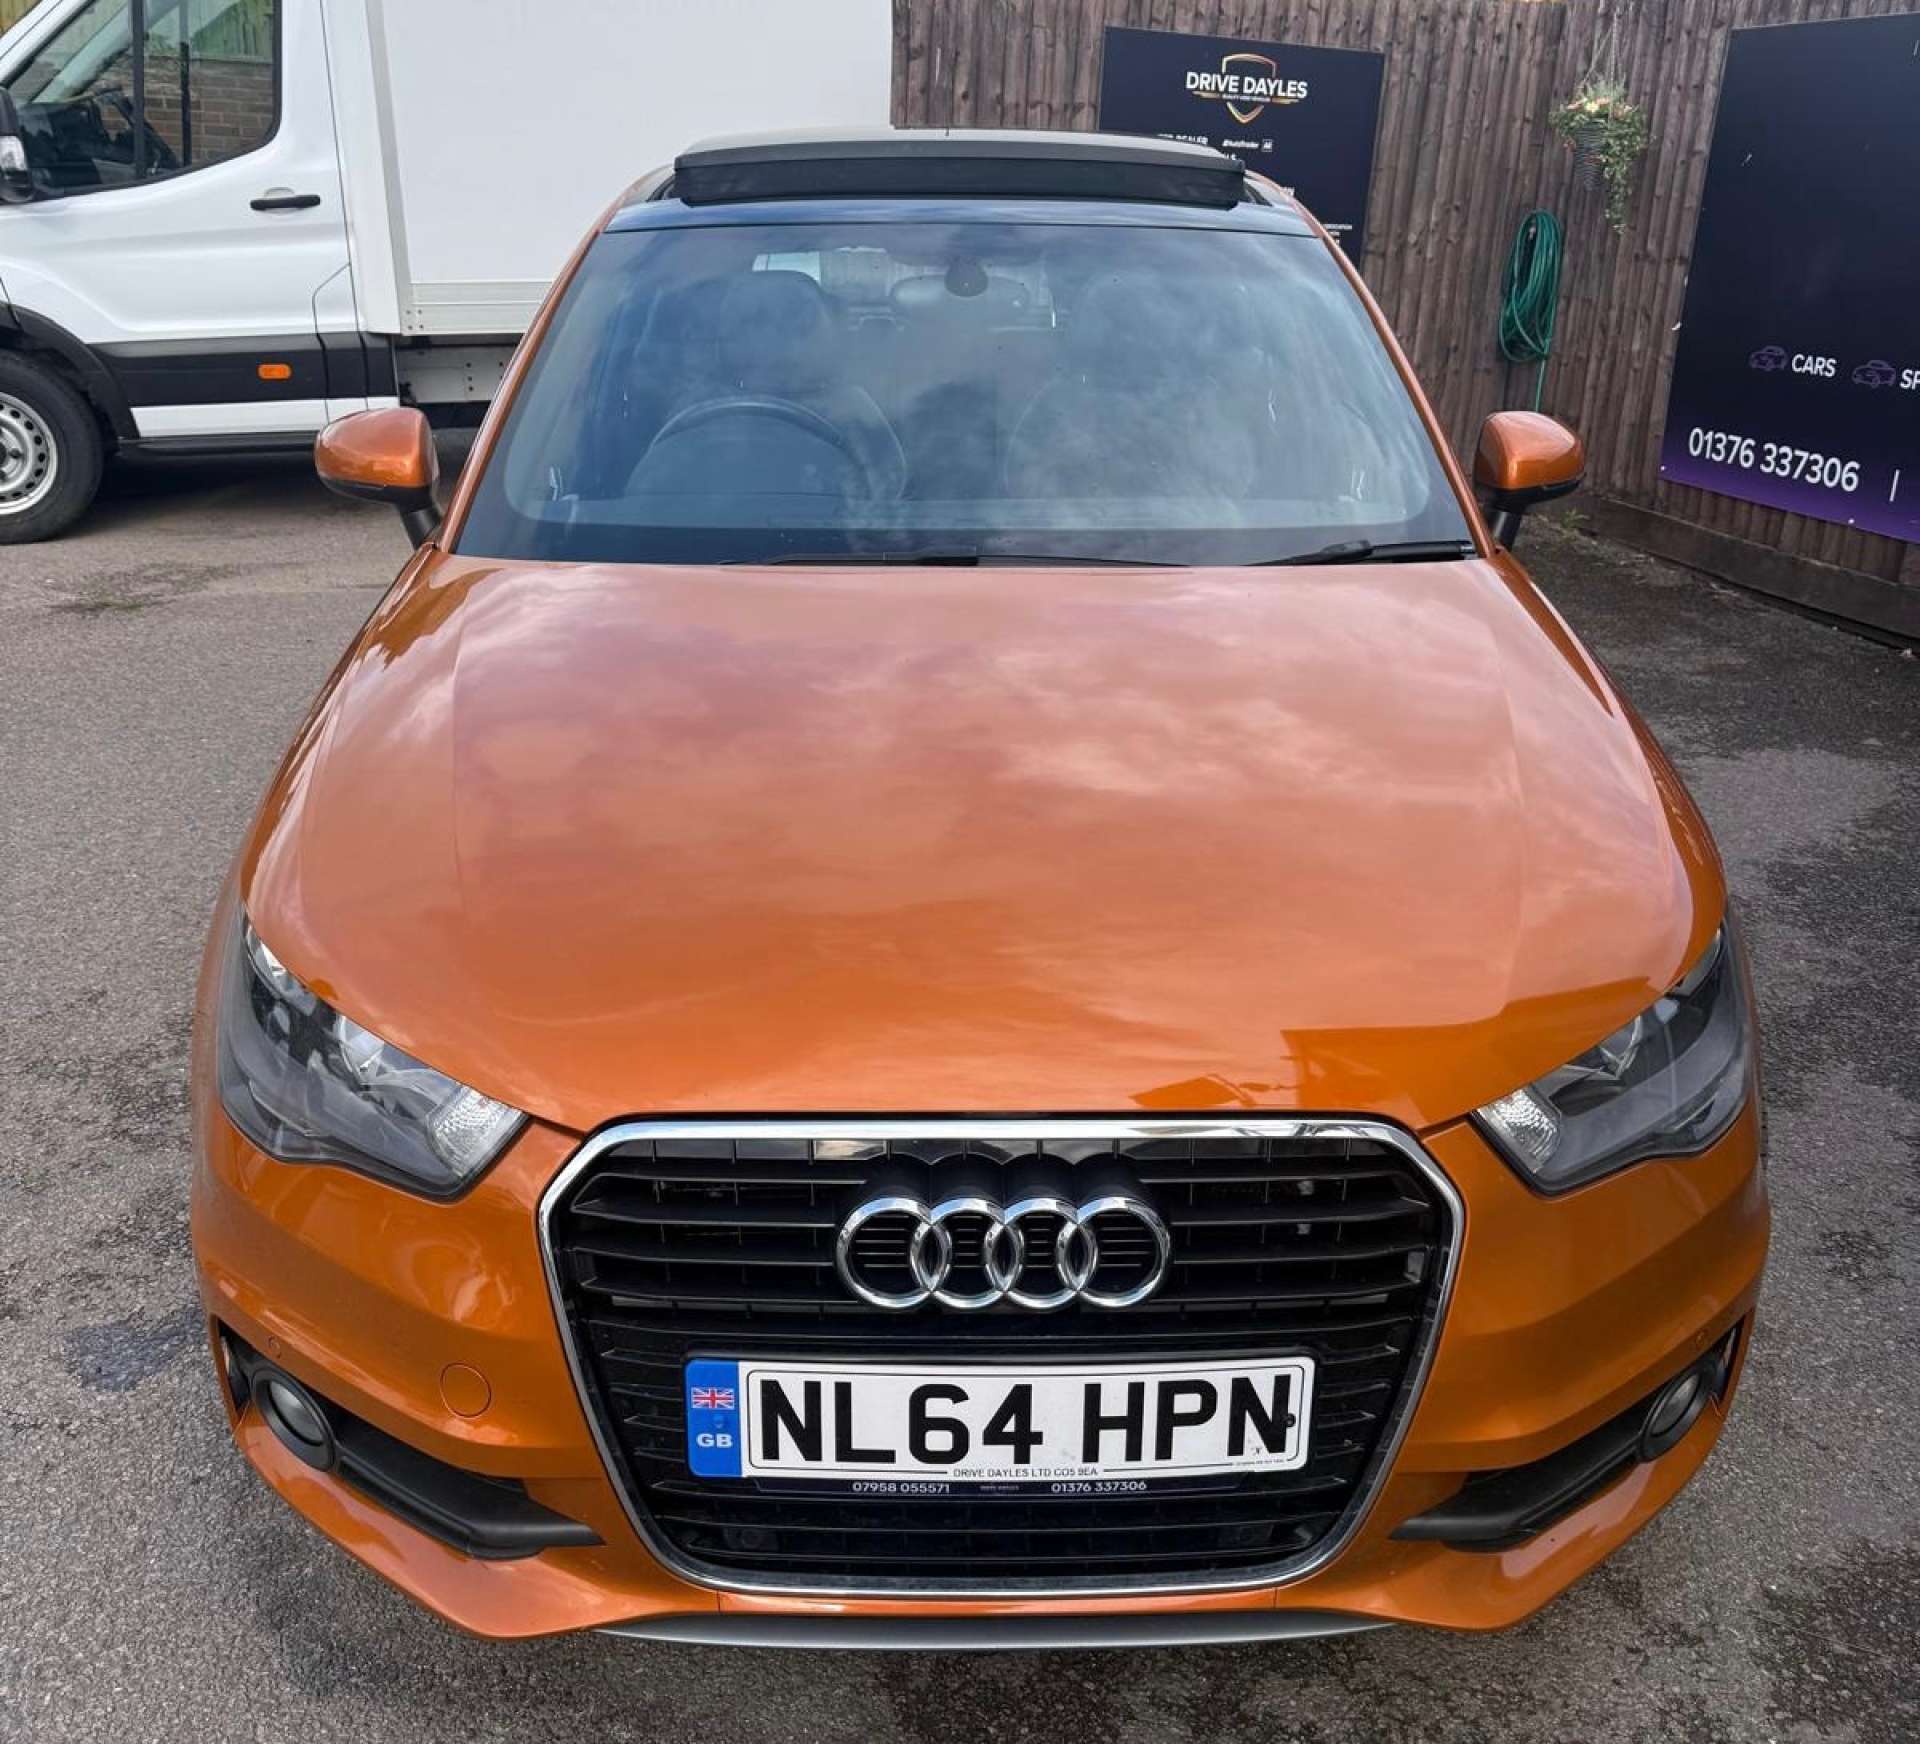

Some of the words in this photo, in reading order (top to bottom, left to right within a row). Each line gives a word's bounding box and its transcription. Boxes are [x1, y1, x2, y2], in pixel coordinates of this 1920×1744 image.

[1186, 72, 1240, 92] DRIVE
[1242, 77, 1308, 99] DAYLES
[1791, 354, 1837, 377] CARS
[1688, 427, 1756, 468] 01376
[1760, 443, 1861, 492] 337306
[760, 1379, 1043, 1465] NL64
[1082, 1374, 1292, 1462] HPN
[696, 1433, 733, 1448] GB
[953, 1469, 985, 1478] DRIVE
[987, 1469, 1029, 1477] DAYLES
[1031, 1468, 1051, 1477] LTD
[852, 1481, 897, 1492] 07958
[900, 1482, 950, 1494] 055571
[1051, 1482, 1092, 1493] 01376
[1095, 1481, 1147, 1492] 337306
